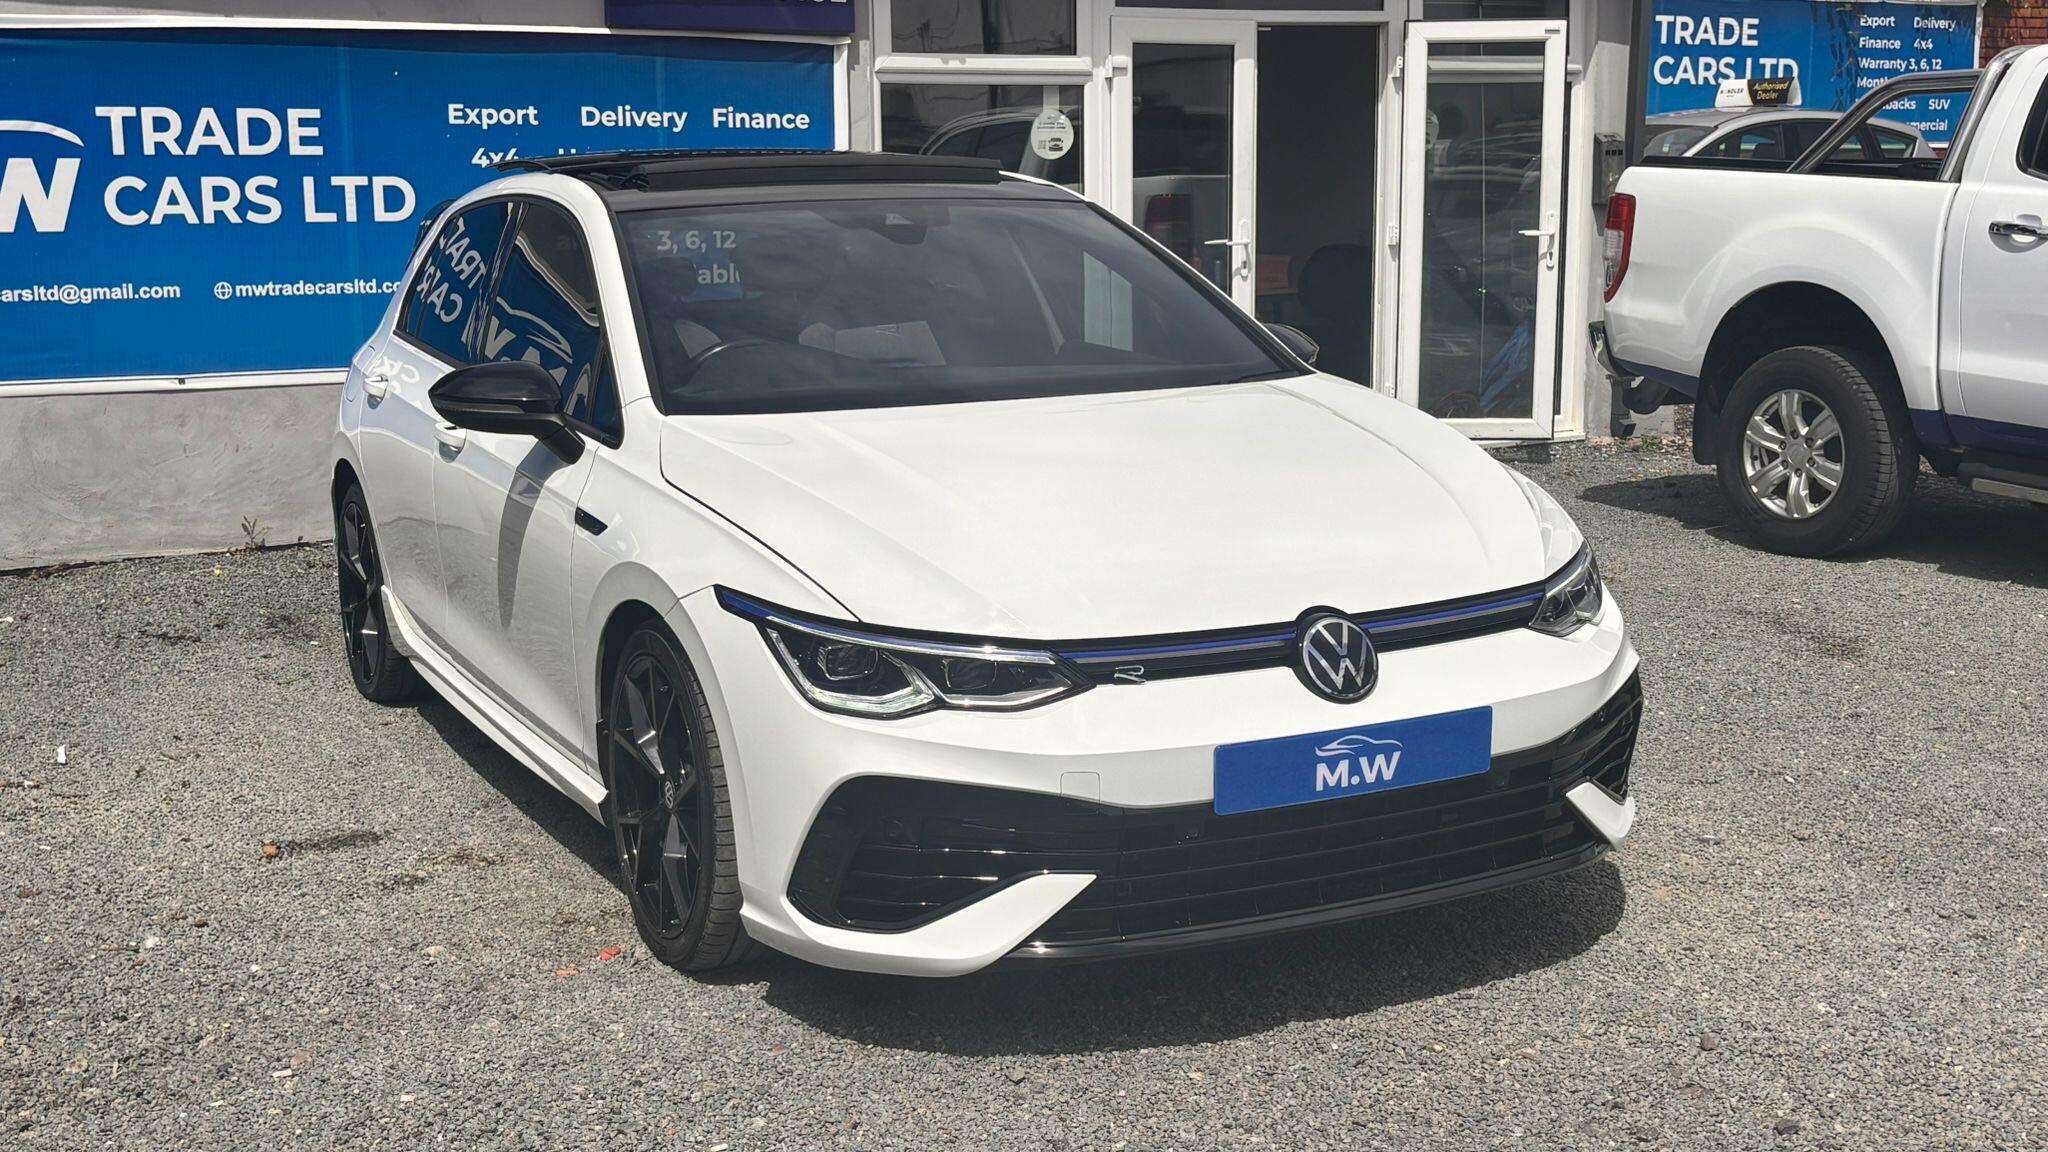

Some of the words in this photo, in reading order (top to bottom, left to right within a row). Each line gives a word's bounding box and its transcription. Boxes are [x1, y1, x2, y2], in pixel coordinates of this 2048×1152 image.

[1654, 15, 1760, 47] TRADE
[1860, 15, 1896, 29] Export
[1913, 17, 1957, 32] Delivery
[1859, 37, 1901, 49] Finance
[1913, 38, 1934, 50] 4x4
[1653, 55, 1736, 86] CARS
[1858, 57, 1907, 72] Warranty
[1908, 59, 1918, 71] 3,
[1919, 59, 1930, 71] 6,
[1931, 59, 1943, 70] 12
[448, 103, 539, 130] Export
[580, 104, 688, 132] Delivery
[712, 106, 811, 130] Finance
[1928, 99, 1951, 110] SUV
[95, 106, 324, 156] TRADE
[104, 175, 282, 226] CARS
[302, 175, 416, 224] LTD
[656, 230, 679, 254] 3,
[684, 230, 707, 253] 6,
[712, 230, 737, 249] 12
[0, 283, 182, 304] arsltd@gmail.com
[1314, 750, 1402, 792] M.W
